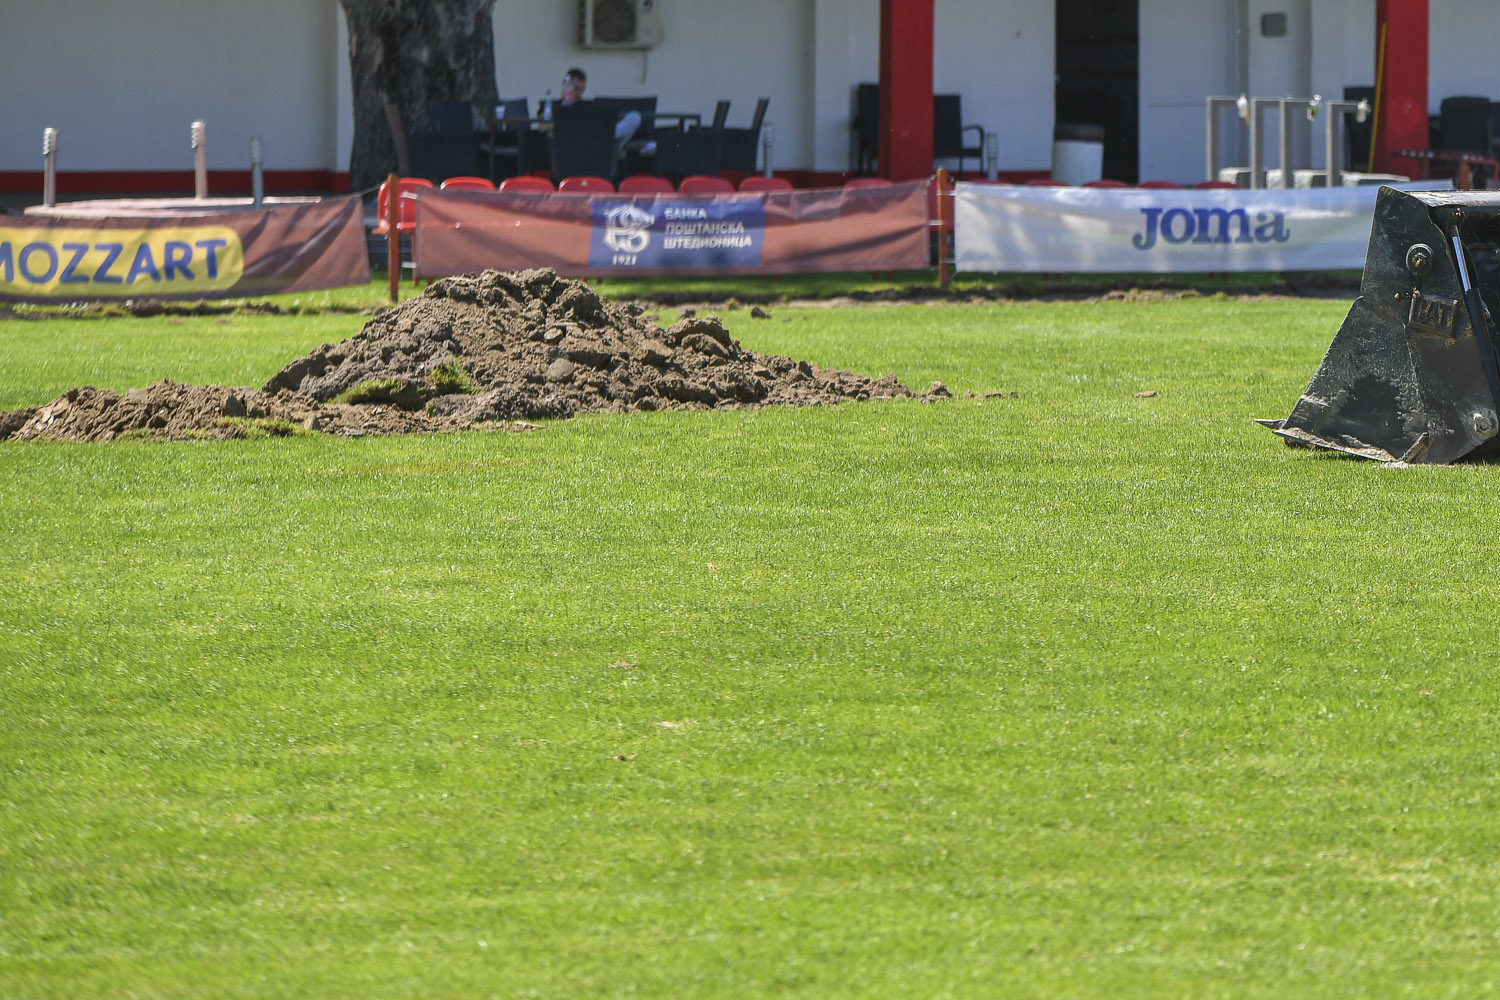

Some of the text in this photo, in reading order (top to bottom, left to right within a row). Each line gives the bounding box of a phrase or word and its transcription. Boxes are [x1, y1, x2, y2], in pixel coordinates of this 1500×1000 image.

[664, 207, 707, 220] БАНКА
[664, 221, 745, 236] ПОШТАНСКА
[663, 236, 753, 250] ШТЕДИОНИЦА
[612, 254, 637, 266] 1921
